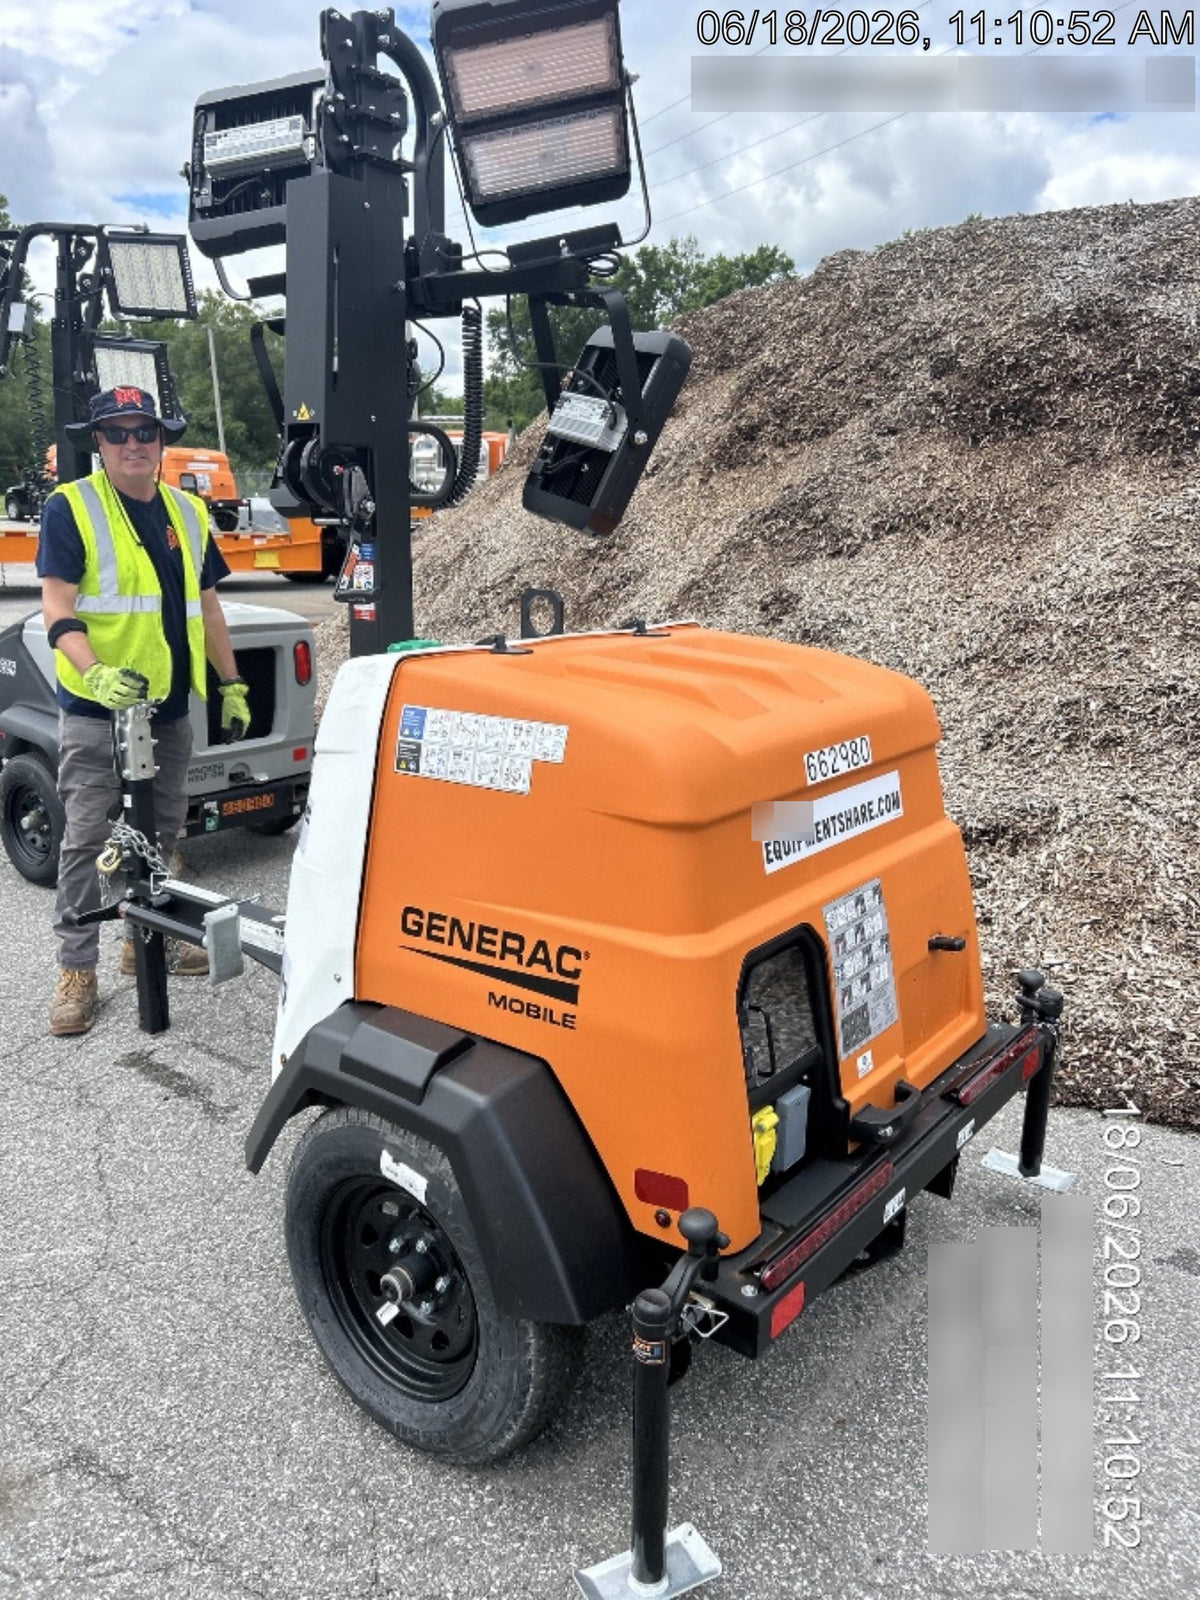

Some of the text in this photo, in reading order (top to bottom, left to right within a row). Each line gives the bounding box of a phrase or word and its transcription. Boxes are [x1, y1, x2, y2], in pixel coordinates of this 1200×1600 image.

[806, 737, 870, 781] 662980
[764, 790, 900, 864] EQUIENTSHARE.COM
[488, 991, 577, 1030] MOBILE
